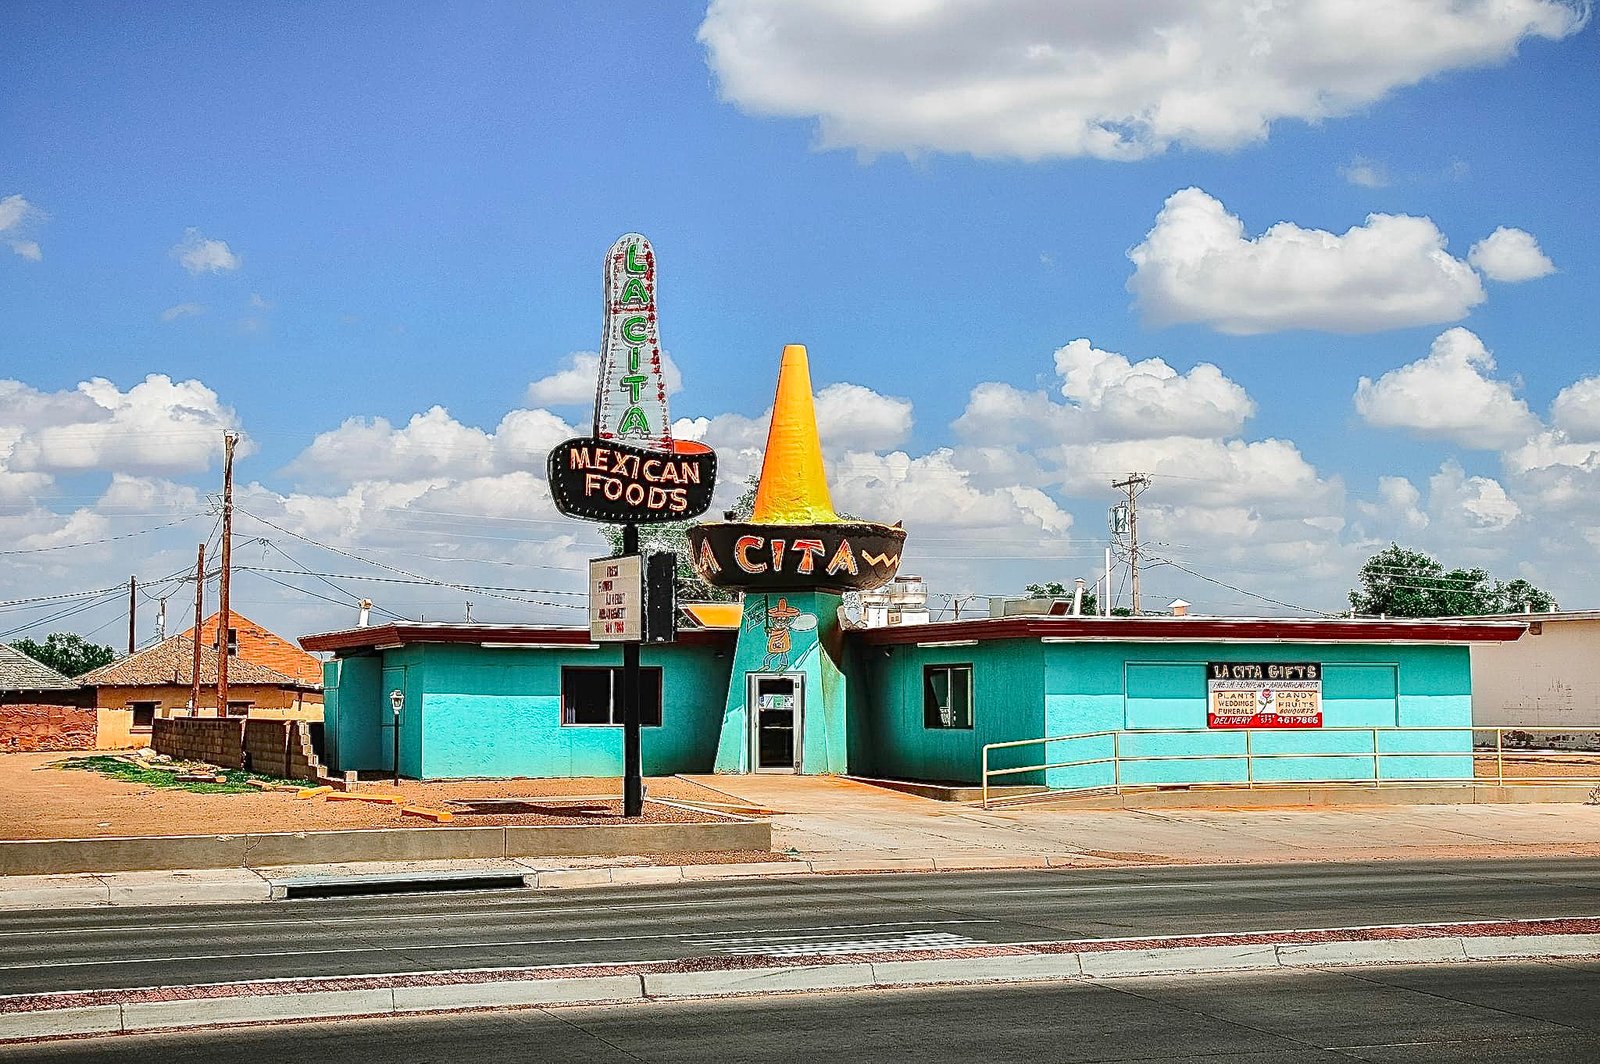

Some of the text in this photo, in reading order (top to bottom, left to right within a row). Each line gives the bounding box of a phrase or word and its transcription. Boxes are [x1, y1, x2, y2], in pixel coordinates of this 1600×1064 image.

[617, 242, 650, 436] LA CITA
[570, 447, 700, 484] MEXICAN
[585, 472, 688, 512] FOODS
[735, 535, 859, 575] CITA
[1213, 664, 1316, 679] LA CITA GIFTS
[1213, 716, 1253, 725] DELIVERY
